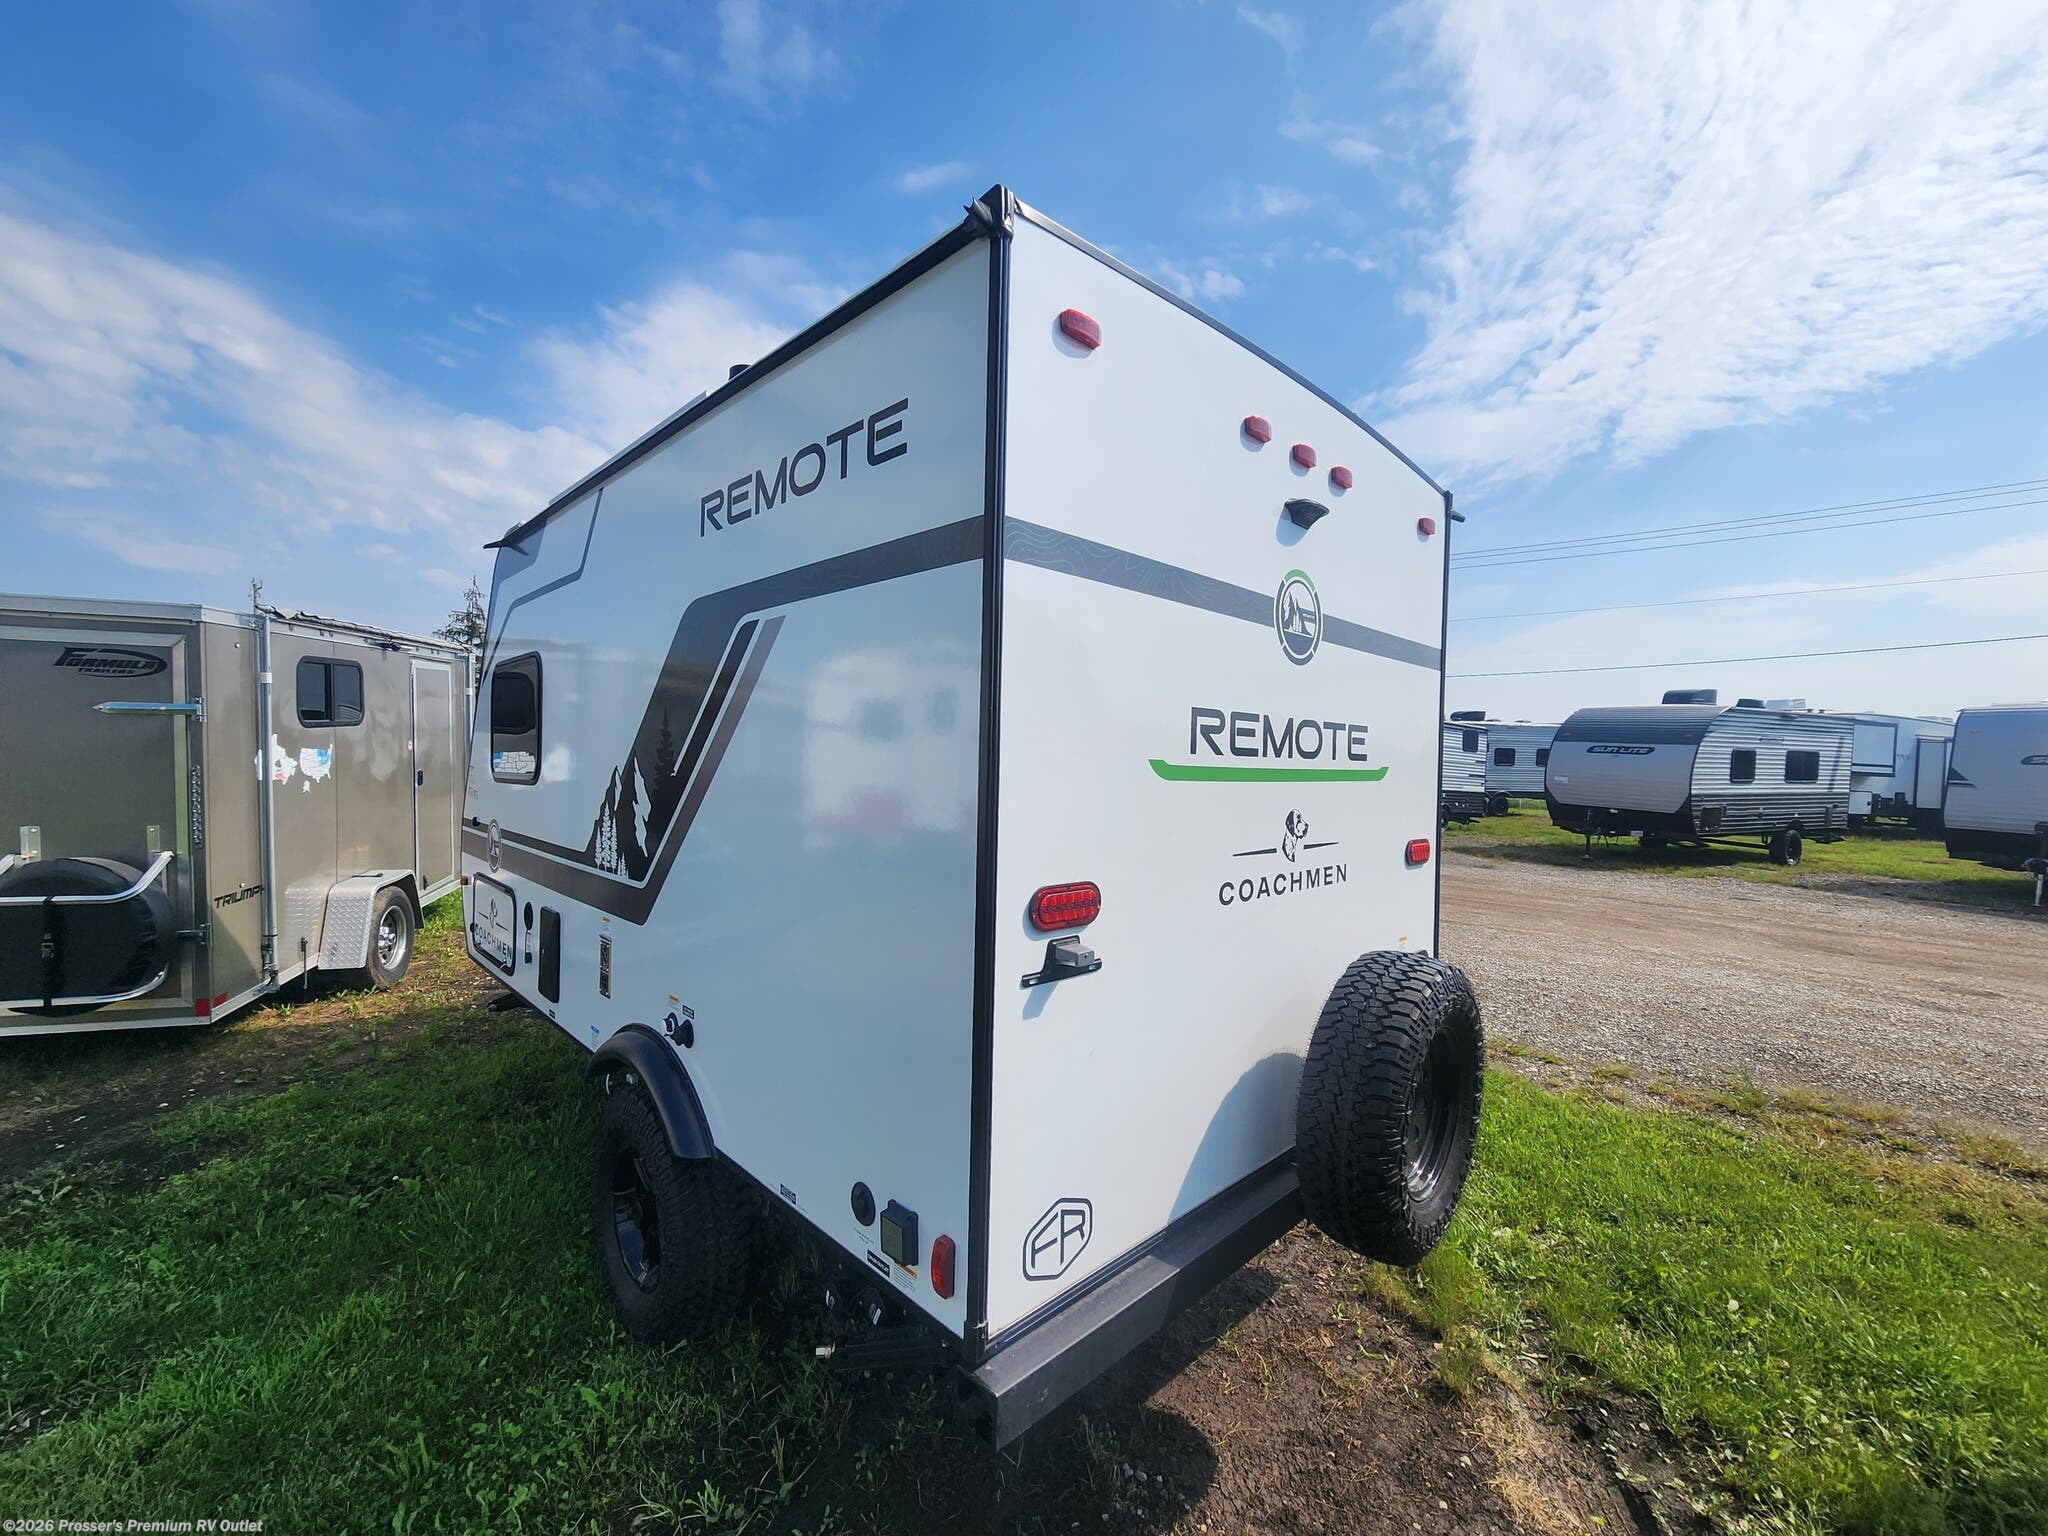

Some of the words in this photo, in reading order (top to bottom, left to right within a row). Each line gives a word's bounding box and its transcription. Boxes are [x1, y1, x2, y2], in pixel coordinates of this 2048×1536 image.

[700, 397, 909, 538] REMOTE
[1190, 706, 1369, 762] REMOTE
[1218, 863, 1348, 906] COACHMEN
[474, 923, 512, 959] COACHMEN
